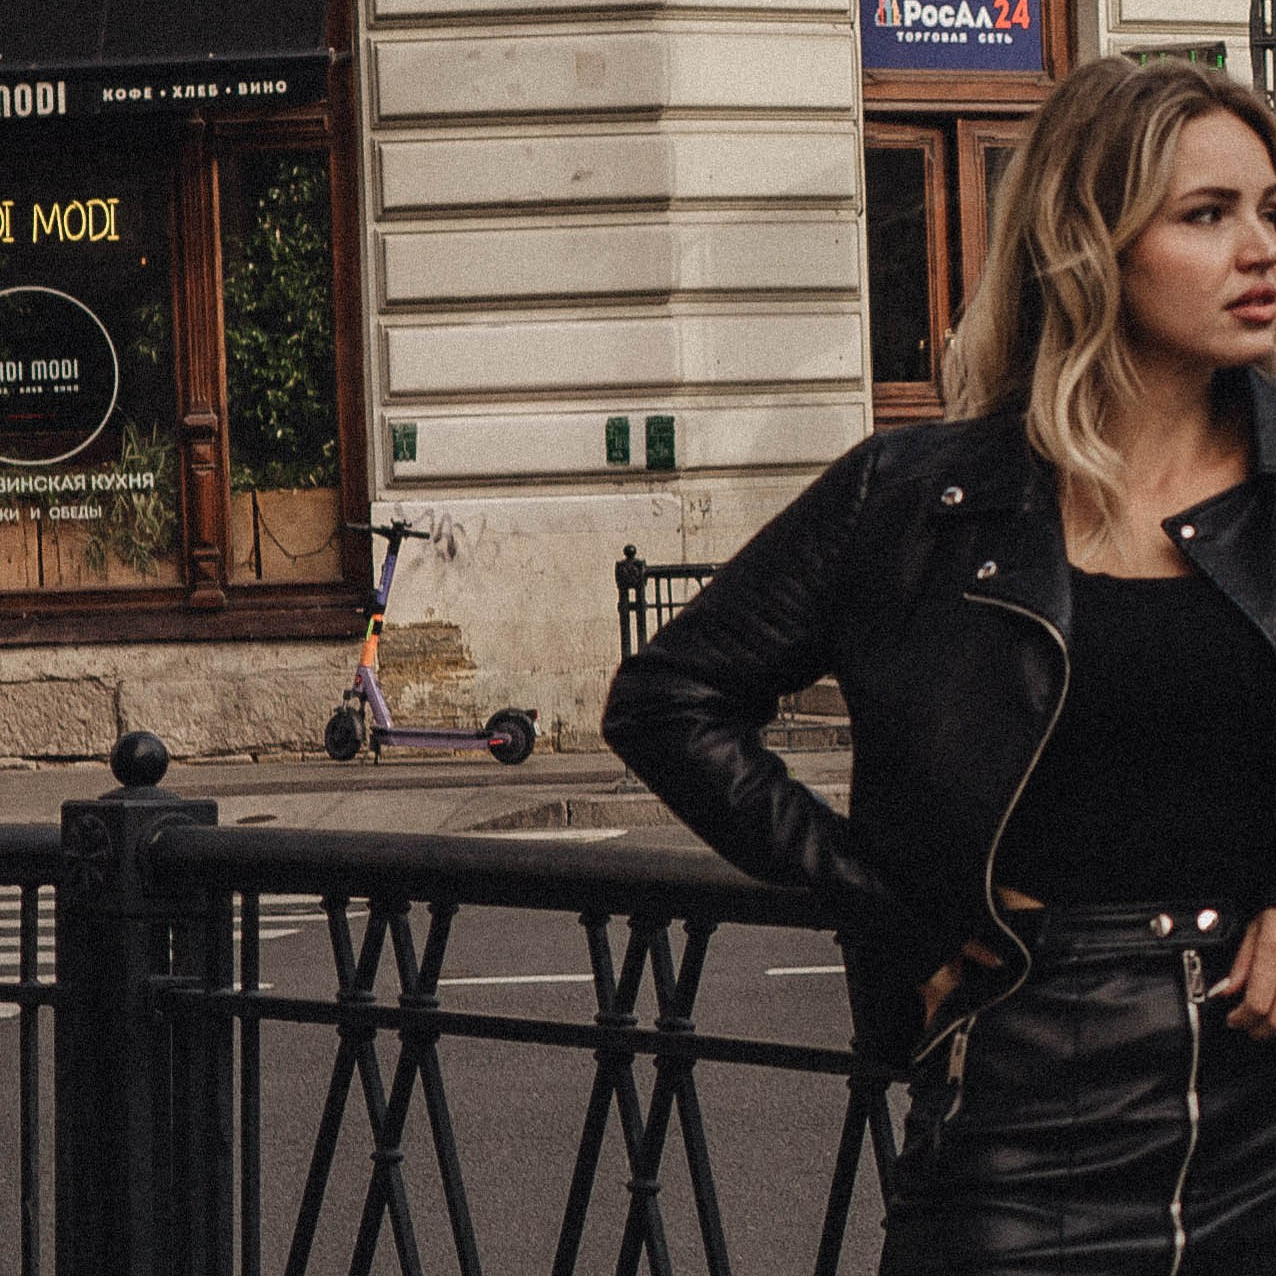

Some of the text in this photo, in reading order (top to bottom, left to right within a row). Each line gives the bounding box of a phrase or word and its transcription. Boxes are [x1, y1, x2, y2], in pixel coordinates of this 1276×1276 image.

[896, 31, 1013, 44] ТОРГОВАЯ СЕТЬ
[103, 80, 287, 102] КОФЕ ХЛЕБ ВИНО
[32, 198, 120, 244] MODI
[31, 358, 79, 381] MODI
[91, 472, 154, 492] КУХНЯ
[30, 506, 41, 521] И
[49, 505, 102, 521] ОБЕДЫ
